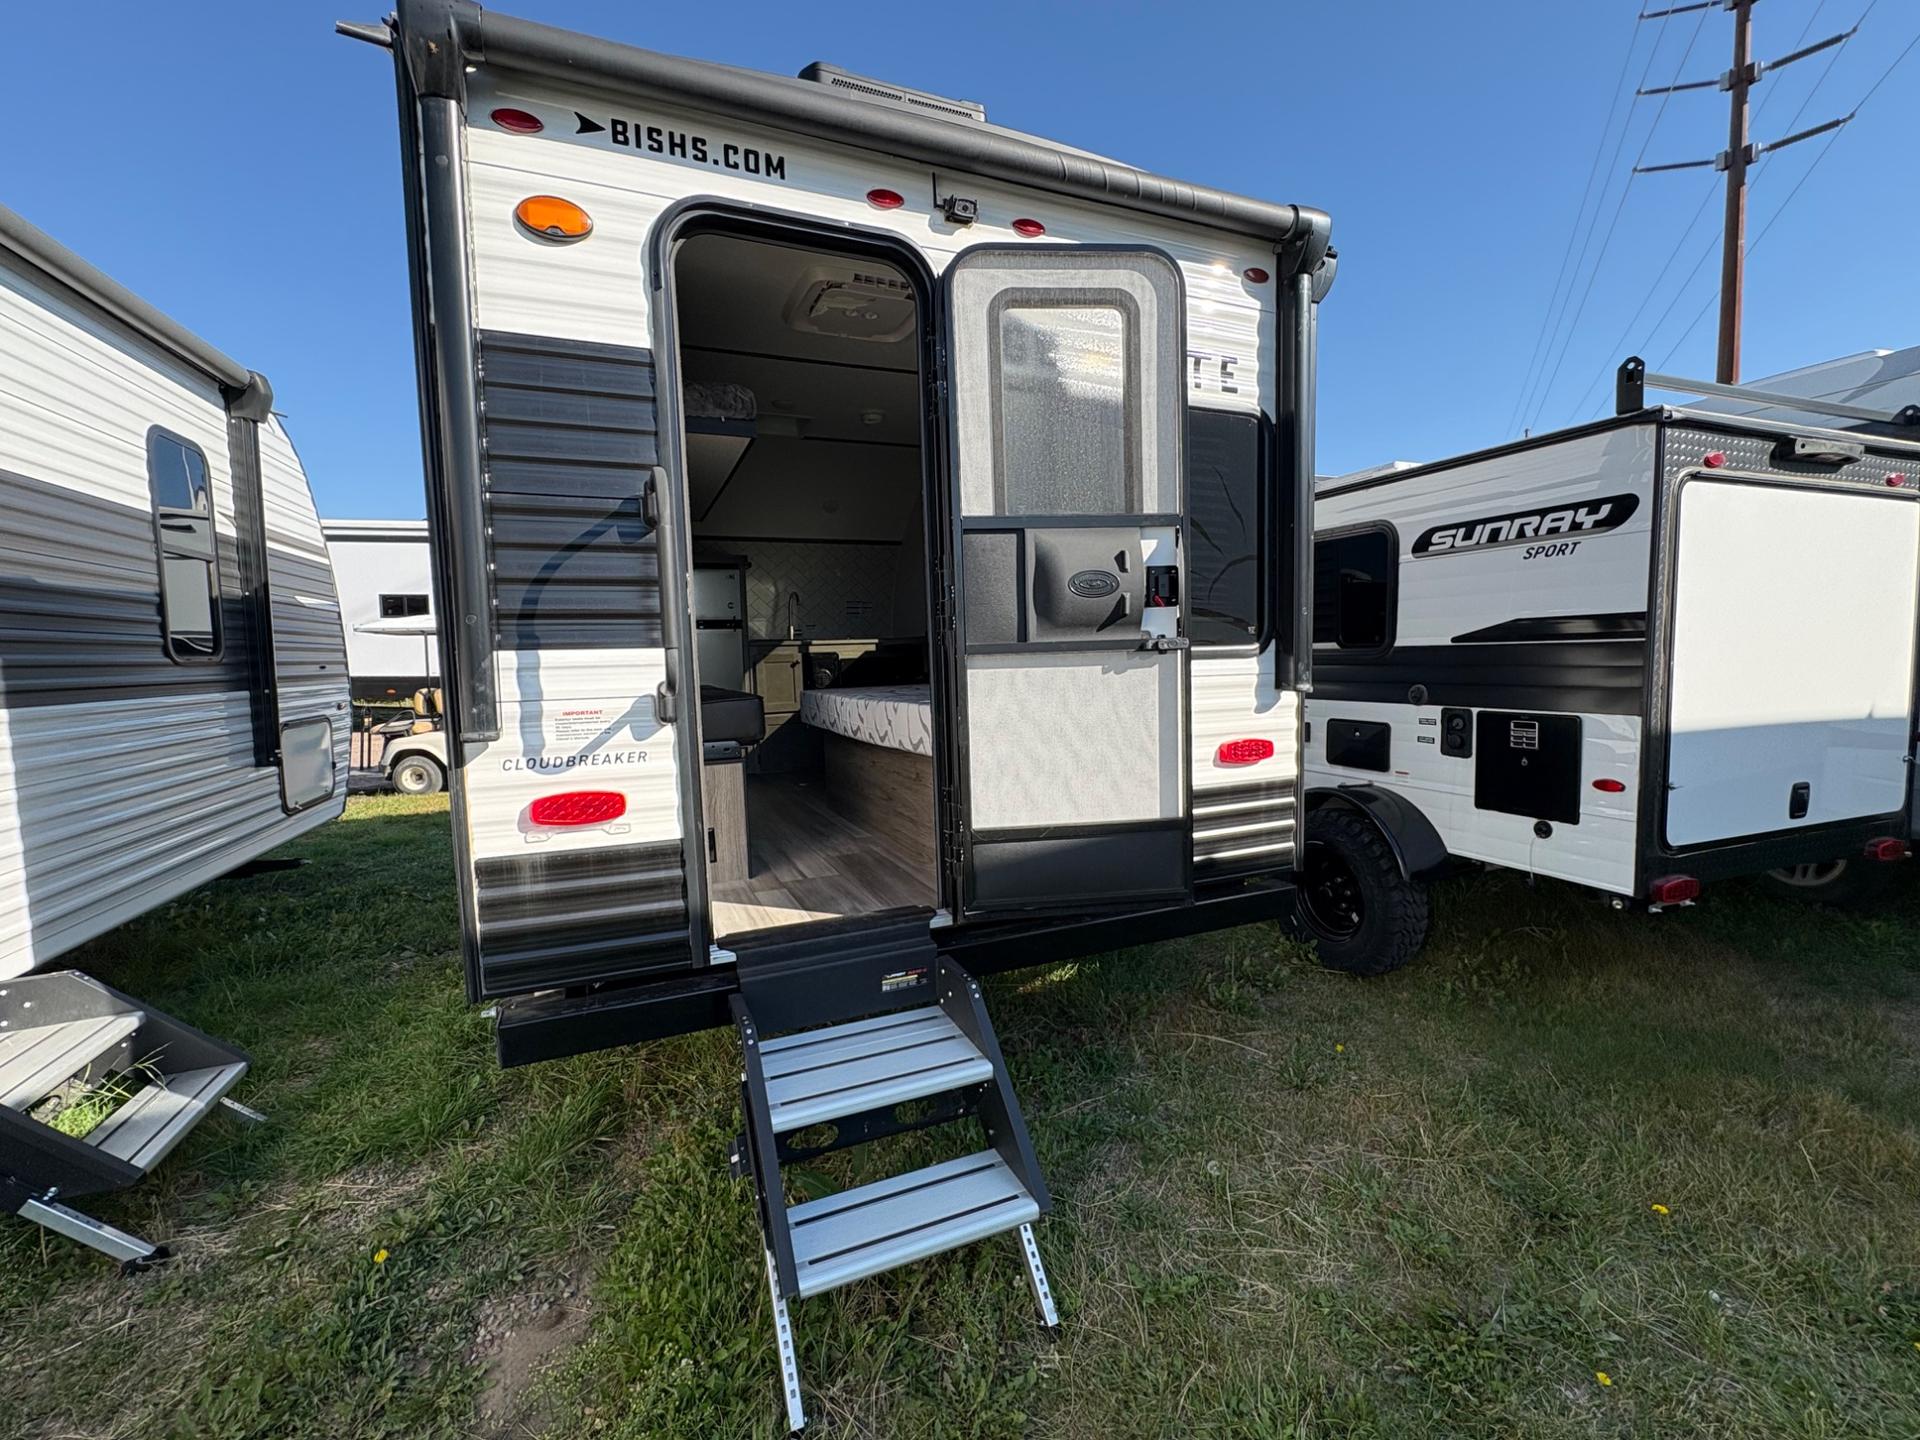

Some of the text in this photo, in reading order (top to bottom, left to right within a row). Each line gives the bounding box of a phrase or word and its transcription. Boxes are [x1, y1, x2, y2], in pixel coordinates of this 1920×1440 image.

[611, 118, 786, 180] BISHS.COM
[1428, 503, 1613, 551] SUNRAY
[1523, 541, 1581, 560] SPORT
[562, 709, 603, 717] IMPORTANT
[502, 751, 648, 771] CLOUDBREAKER
